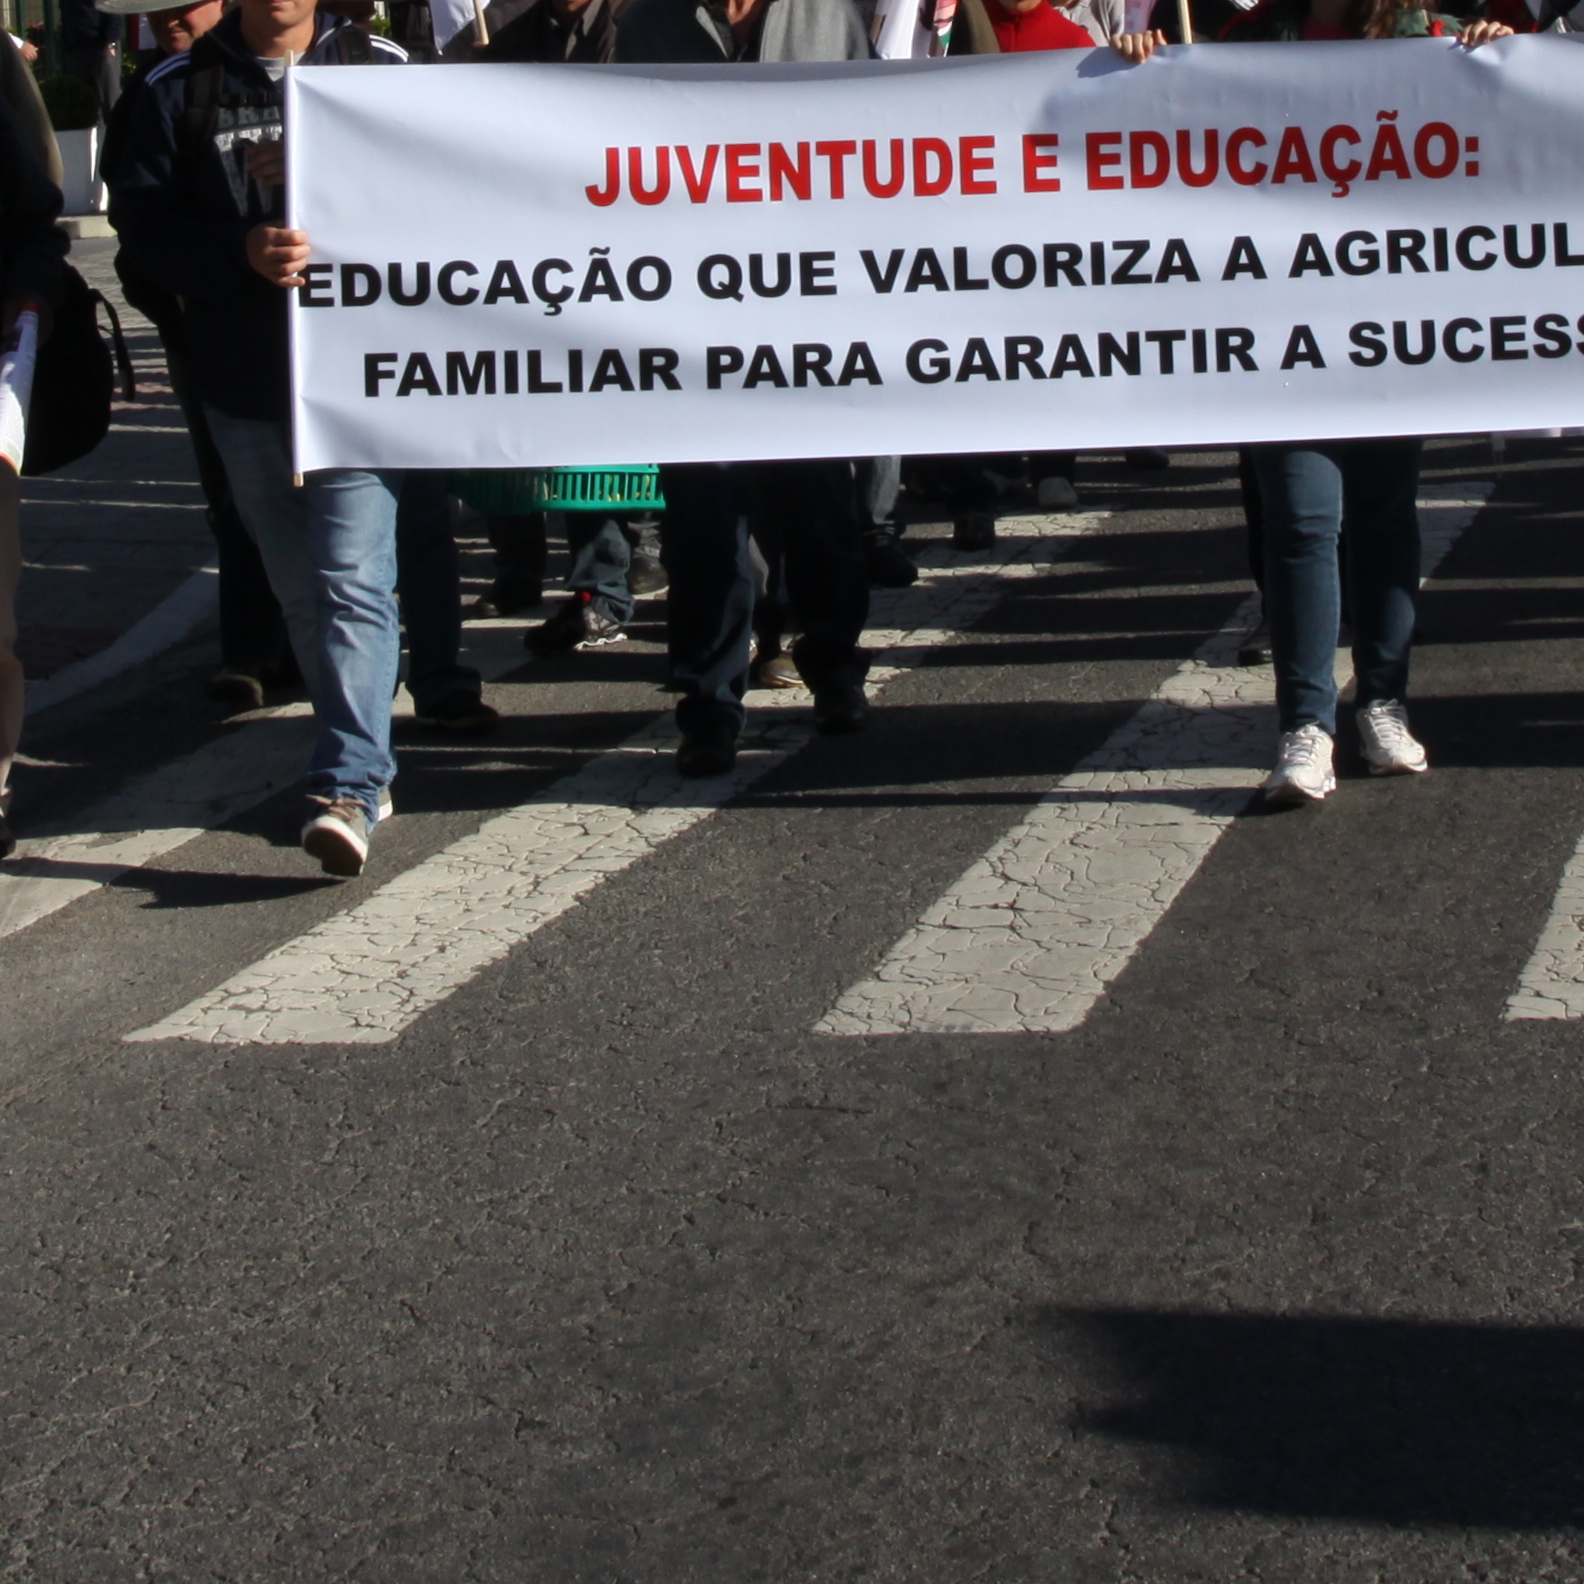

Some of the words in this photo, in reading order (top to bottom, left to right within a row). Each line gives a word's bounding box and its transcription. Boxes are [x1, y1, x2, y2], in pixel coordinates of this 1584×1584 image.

[585, 134, 998, 208] JUVENTUDE
[1022, 133, 1062, 194] E
[1086, 110, 1481, 198] EDUCAÇÃO:
[296, 246, 673, 317] EDUCAÇÃO
[696, 250, 838, 304] QUE
[859, 235, 1201, 295] VALORIZA
[1221, 235, 1268, 282] A
[363, 347, 683, 398] FAMILIAR
[705, 337, 884, 391] PARA
[905, 326, 1260, 385] GARANTIR
[1279, 323, 1327, 371] A
